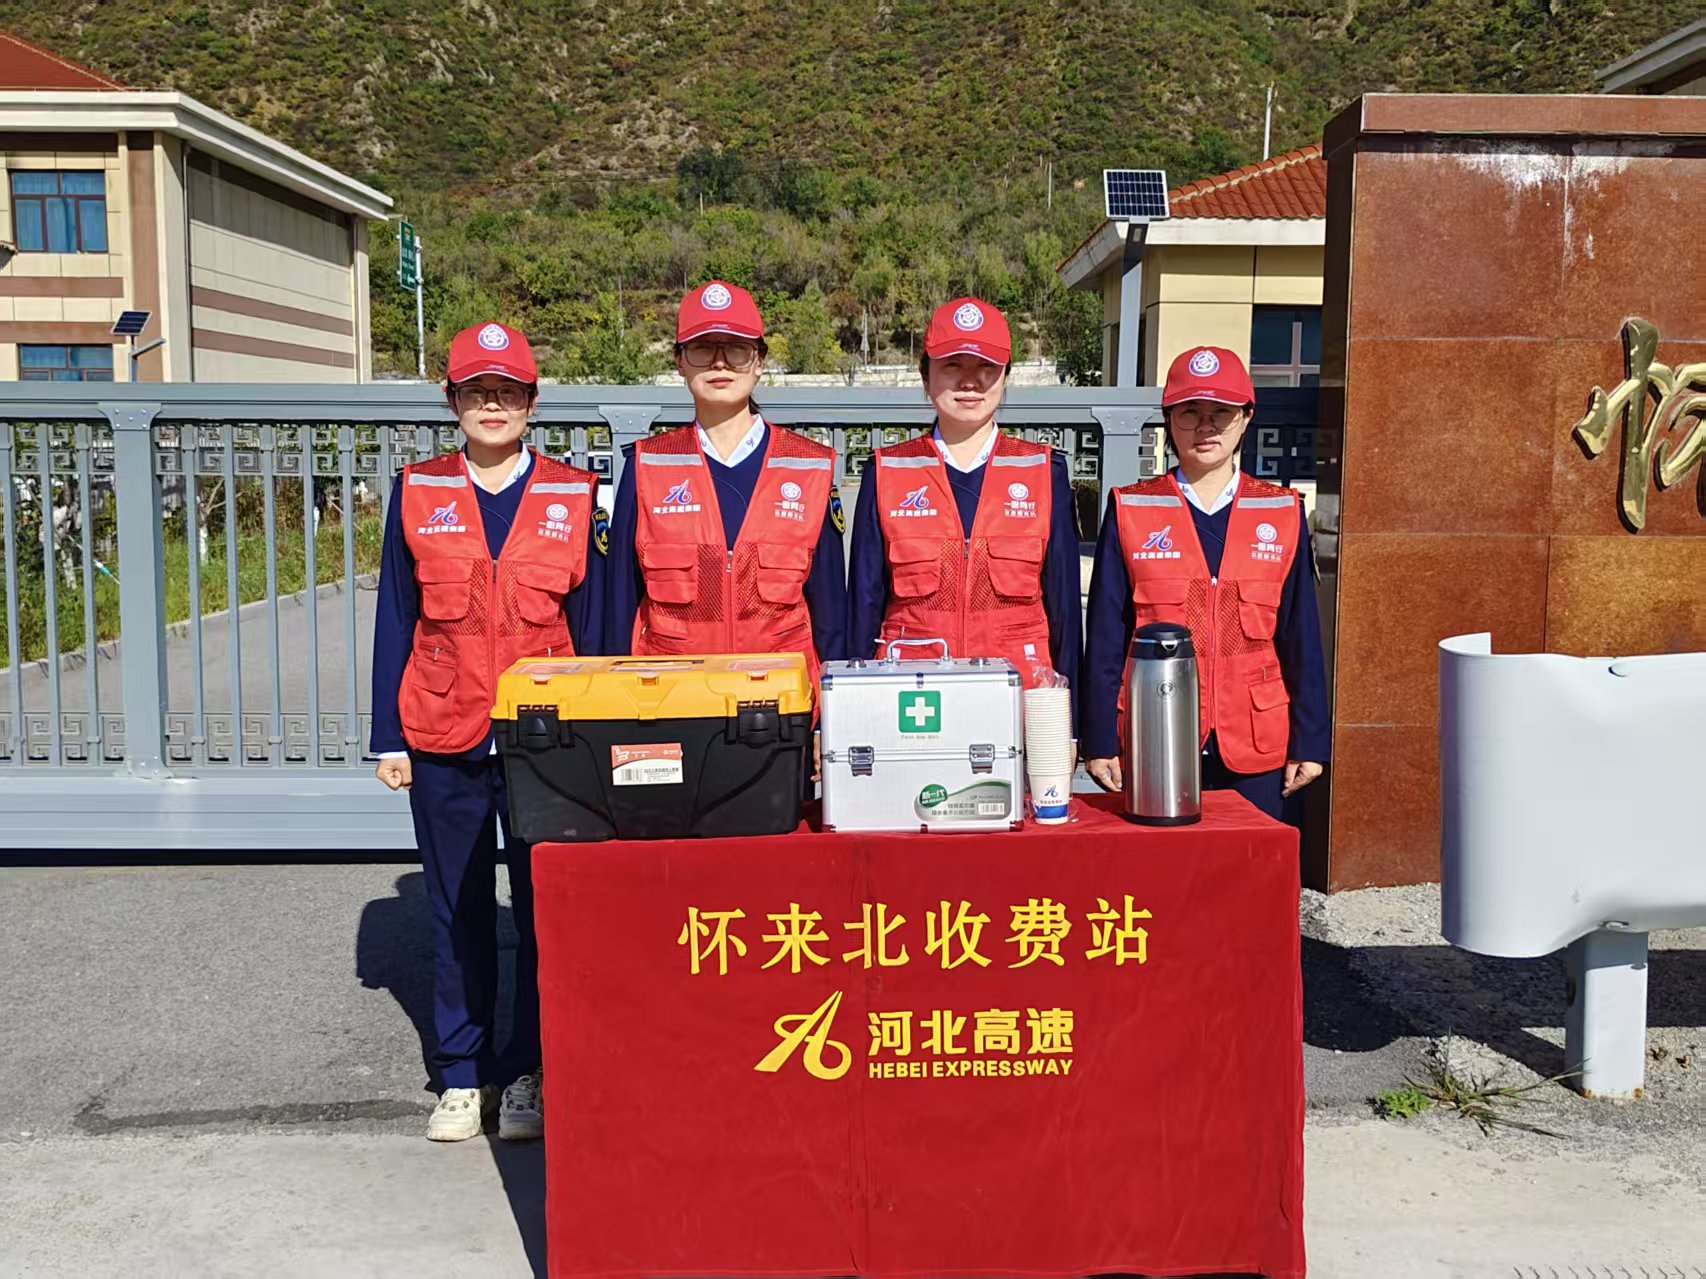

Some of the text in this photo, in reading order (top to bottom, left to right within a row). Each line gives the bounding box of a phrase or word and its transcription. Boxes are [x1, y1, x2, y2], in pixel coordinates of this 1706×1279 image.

[677, 895, 1153, 976] 怀来北收费站
[867, 1007, 1074, 1057] 河北高速
[868, 1058, 1073, 1079] HEBEI EXPRESSWAY
